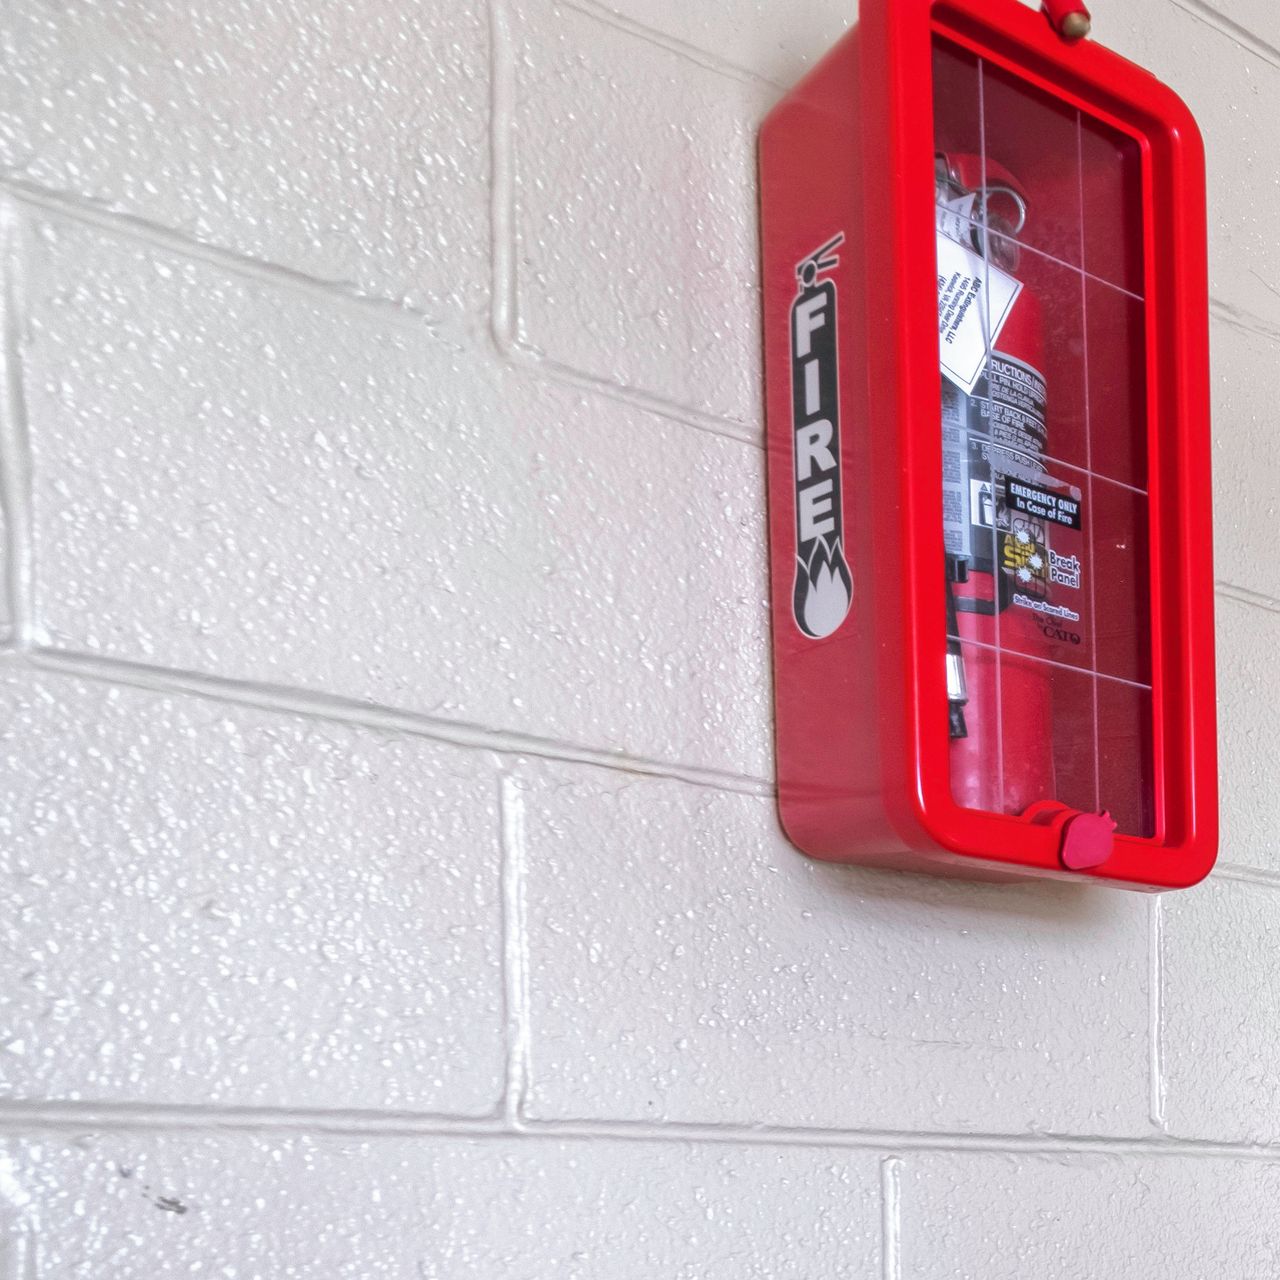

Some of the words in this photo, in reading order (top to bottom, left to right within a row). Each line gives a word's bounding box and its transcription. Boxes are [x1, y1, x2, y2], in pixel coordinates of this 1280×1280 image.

[970, 276, 982, 292] ABC
[945, 331, 956, 344] LLC
[796, 292, 837, 543] FIRE
[1010, 483, 1056, 506] EMERGENCY
[1058, 499, 1077, 514] ONLY
[1017, 497, 1025, 508] In
[1027, 501, 1046, 516] Case
[1048, 509, 1056, 519] of
[1058, 510, 1073, 524] Fire
[1049, 551, 1080, 571] Break
[1051, 568, 1079, 587] Panel
[1014, 595, 1032, 607] Strike
[1042, 603, 1062, 615] Scored
[1063, 609, 1078, 620] Lines
